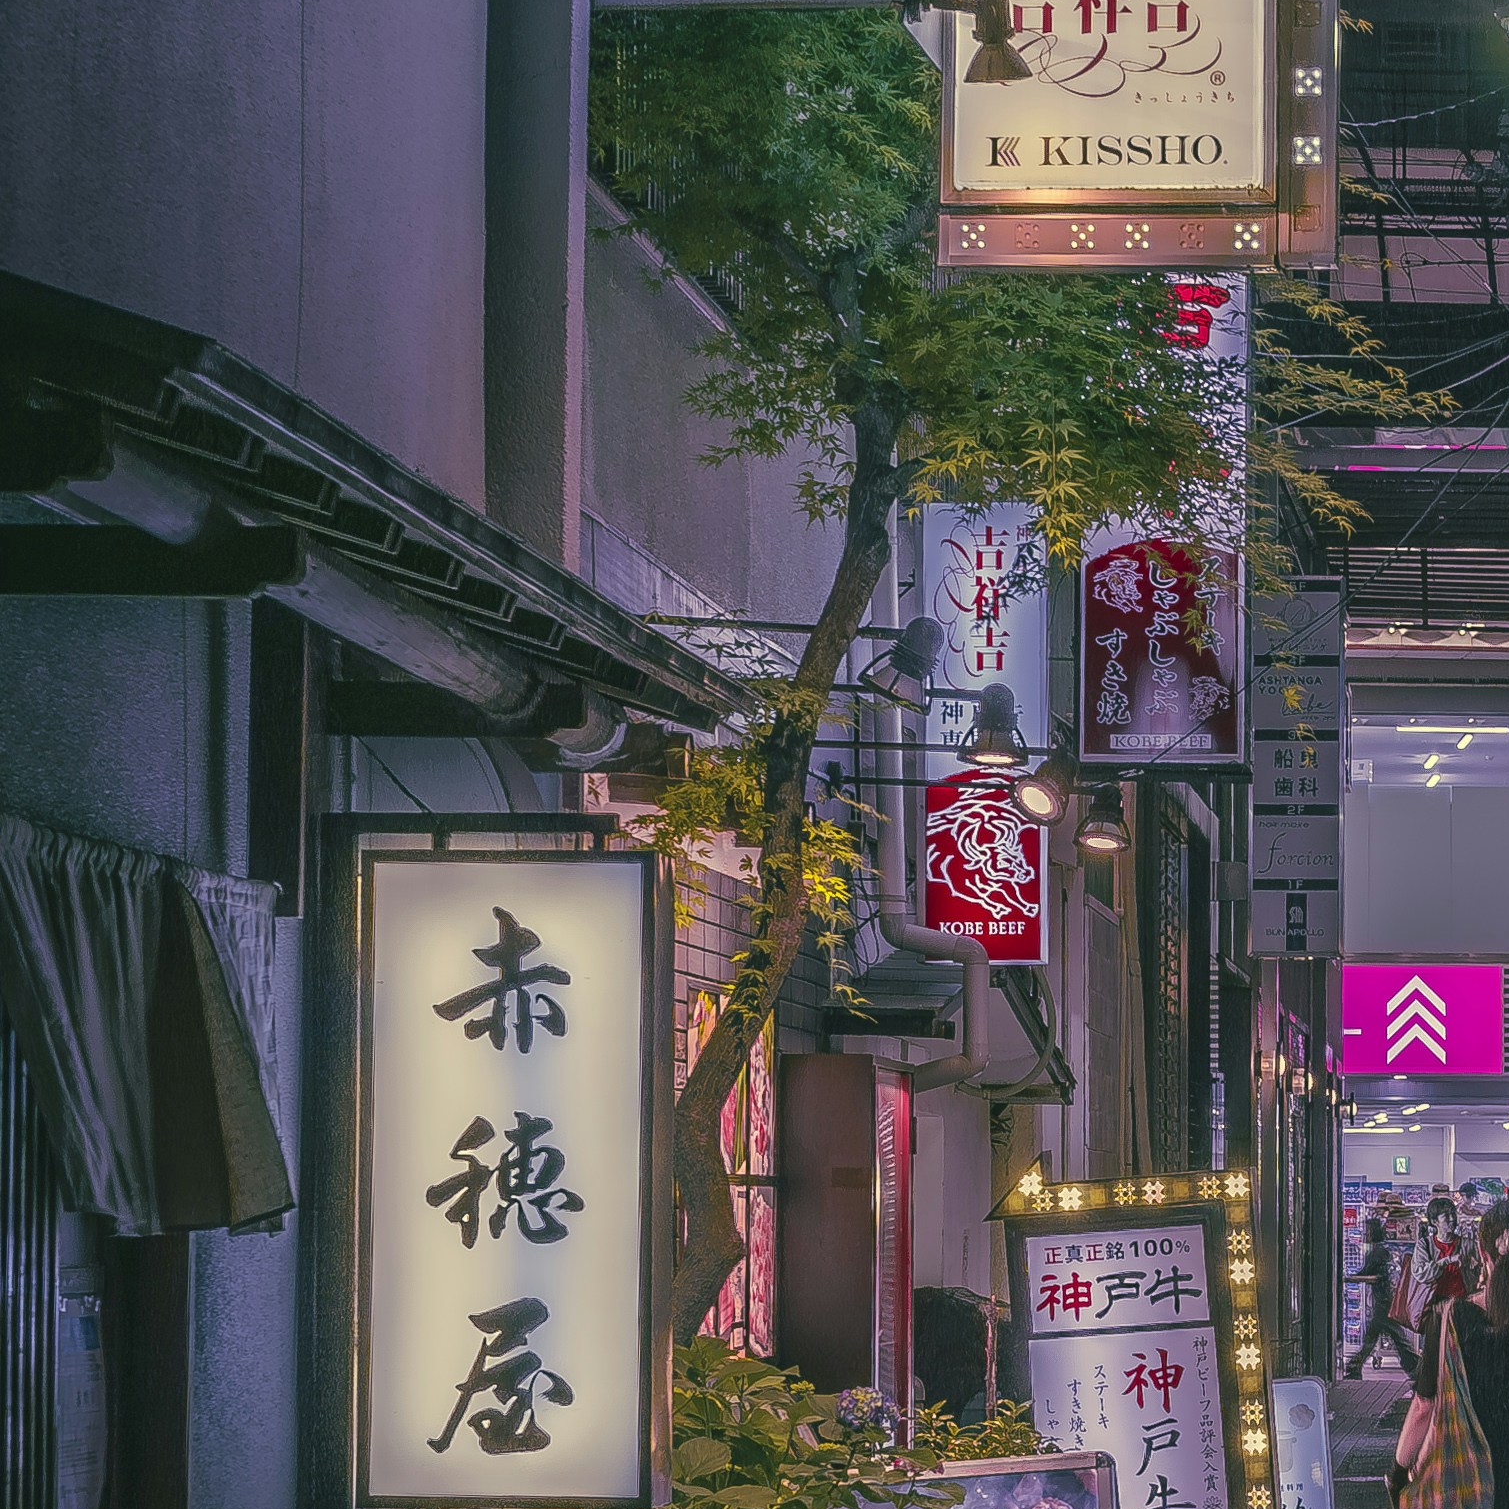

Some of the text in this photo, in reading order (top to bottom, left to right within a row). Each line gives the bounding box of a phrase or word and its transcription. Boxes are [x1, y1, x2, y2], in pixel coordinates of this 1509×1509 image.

[1144, 560, 1180, 716] しゃぶしゃぶ
[1095, 627, 1132, 726] すき焼
[1258, 675, 1322, 685] ASHTANGA
[1114, 736, 1208, 748] KOBE BEEF
[1274, 777, 1318, 797] 歯科
[1288, 805, 1305, 815] 2F
[1288, 880, 1303, 889] 1F
[939, 919, 1026, 937] KOBE BEEF
[425, 906, 586, 1455] 赤穂屋
[1036, 1265, 1204, 1322] 神戸牛
[1093, 1364, 1110, 1429] ステーキ
